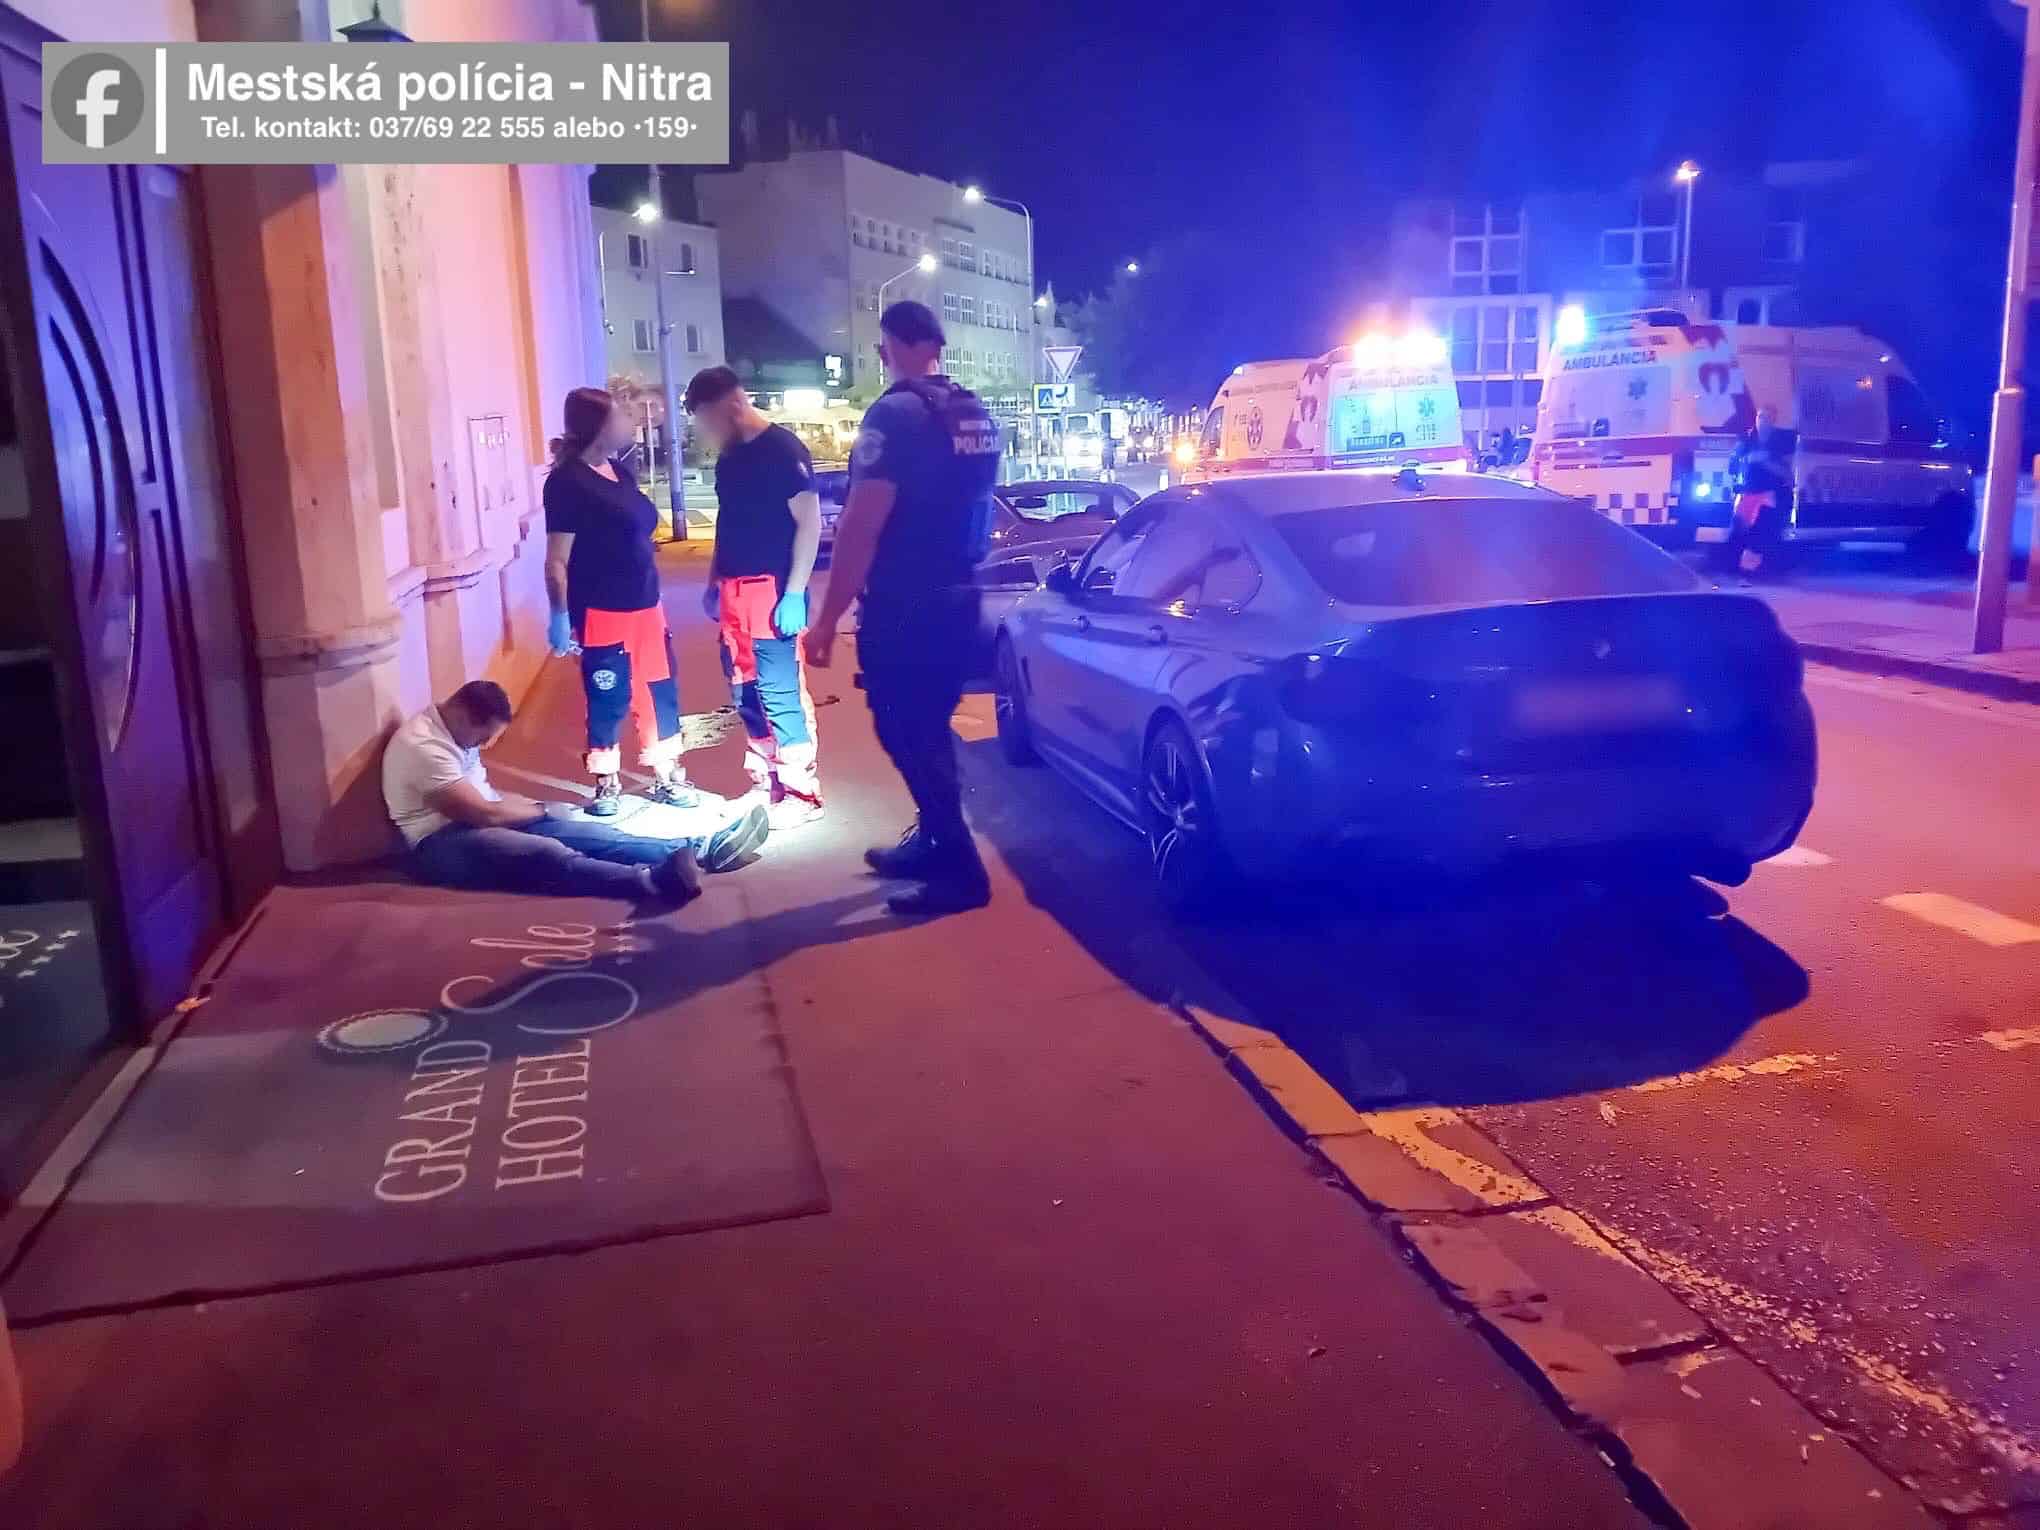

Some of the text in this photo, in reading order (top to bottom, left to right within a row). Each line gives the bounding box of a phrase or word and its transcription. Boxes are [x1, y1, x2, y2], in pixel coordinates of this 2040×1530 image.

[1563, 350, 1657, 371] AMBULANCIA
[440, 923, 639, 1034] Sole
[374, 1039, 492, 1202] GRAND
[495, 1038, 592, 1191] HOTEL
